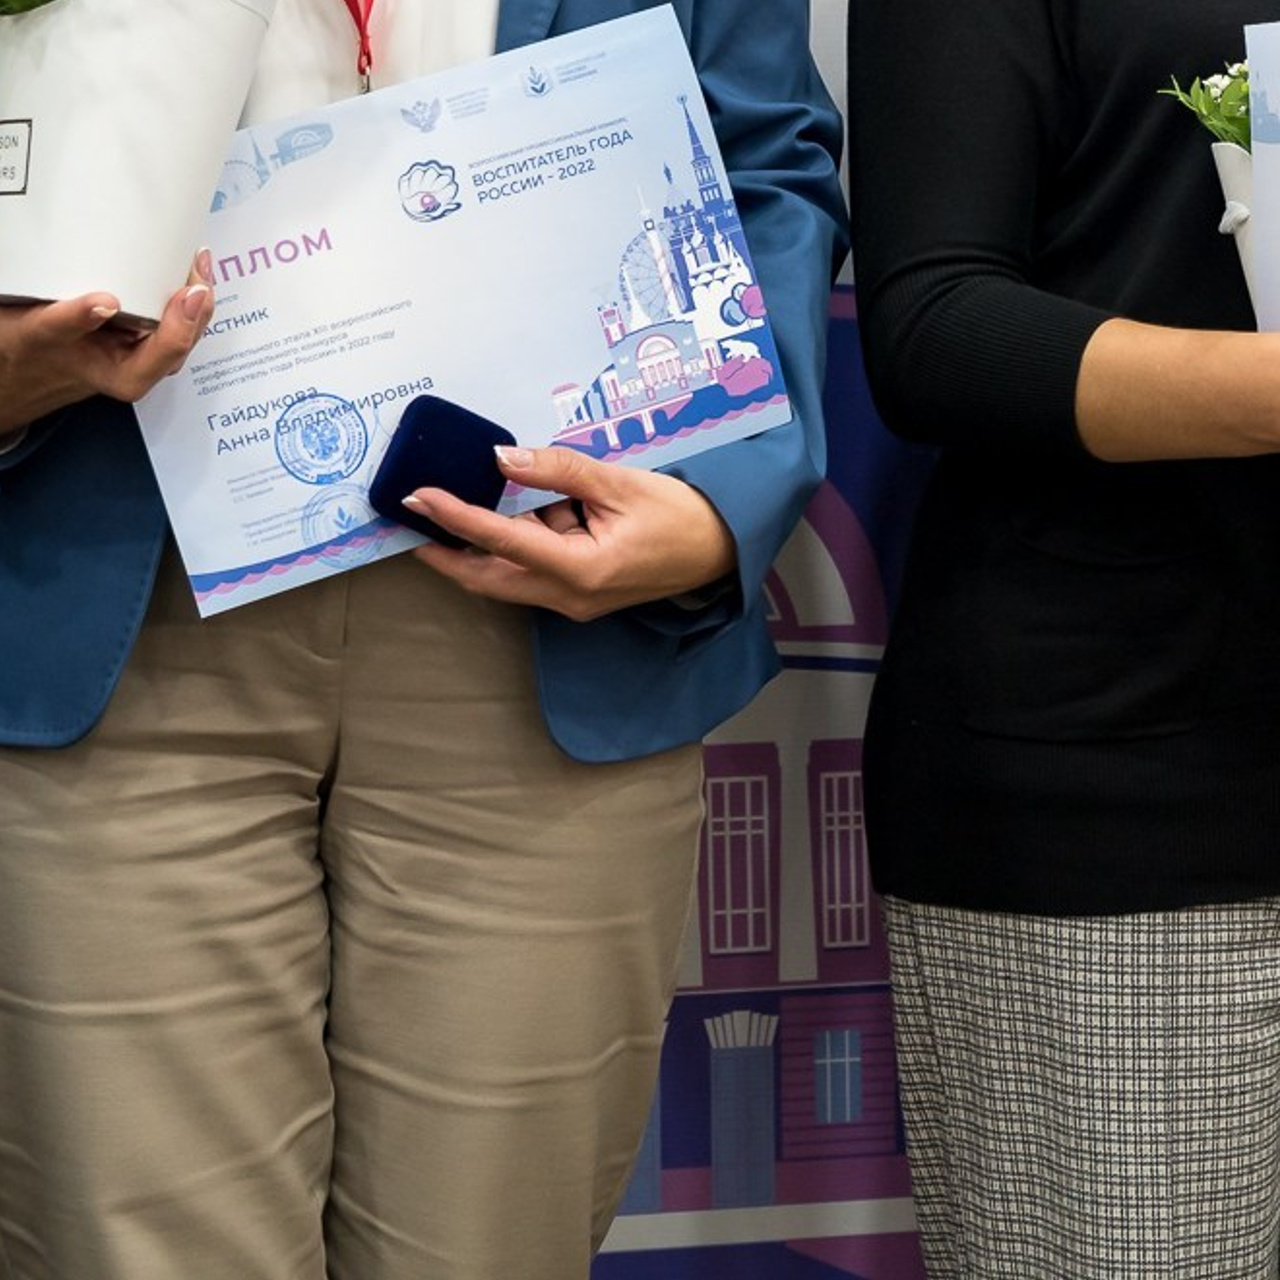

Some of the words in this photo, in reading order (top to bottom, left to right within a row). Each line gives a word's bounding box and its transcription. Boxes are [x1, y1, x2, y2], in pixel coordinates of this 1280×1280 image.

[471, 144, 588, 187] ВОСПИТАТЕЛЬ
[589, 129, 634, 152] ГОДА
[477, 174, 545, 204] РОССИИ
[557, 158, 597, 181] 2022
[348, 335, 371, 351] 2022
[206, 385, 319, 432] Гайдукова
[215, 426, 272, 456] Анна
[275, 375, 435, 437] Владимировна
